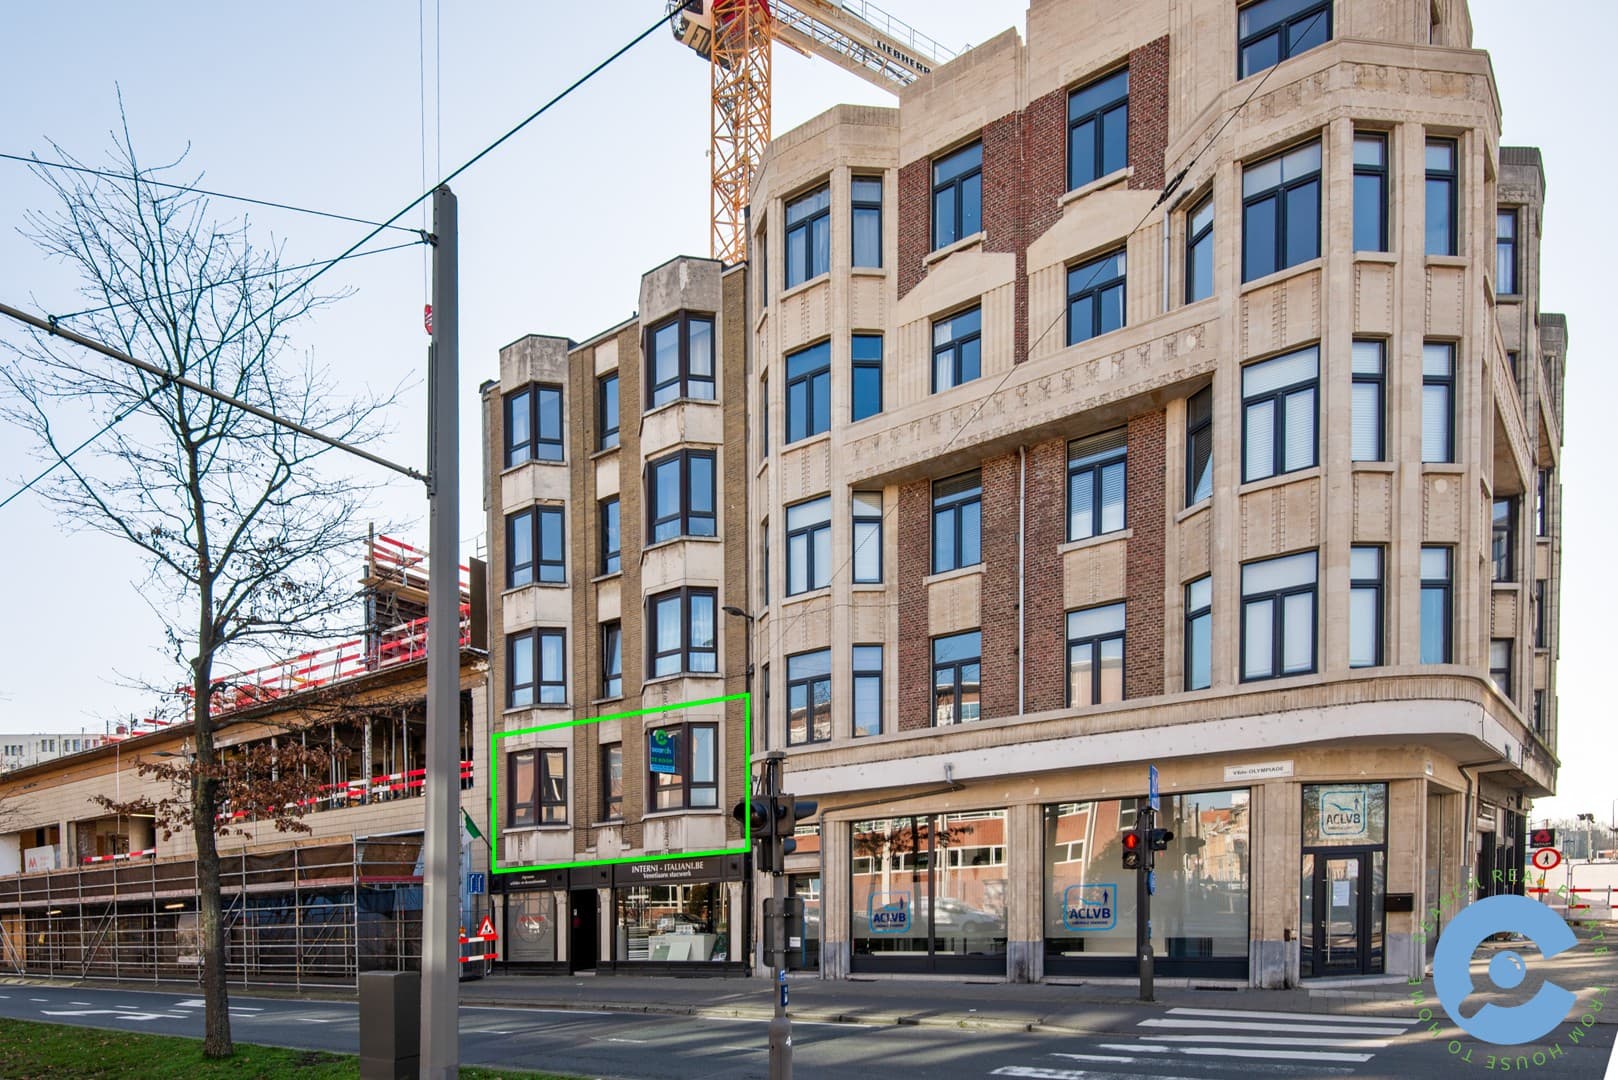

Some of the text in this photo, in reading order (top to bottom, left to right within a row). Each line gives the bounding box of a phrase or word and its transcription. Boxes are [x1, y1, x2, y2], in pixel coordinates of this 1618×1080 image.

[876, 39, 931, 74] LIEBHERR
[1326, 813, 1361, 825] ACLVB
[631, 864, 658, 874] INTERNI
[873, 912, 906, 922] ACLVB
[1069, 907, 1112, 919] ACLVB
